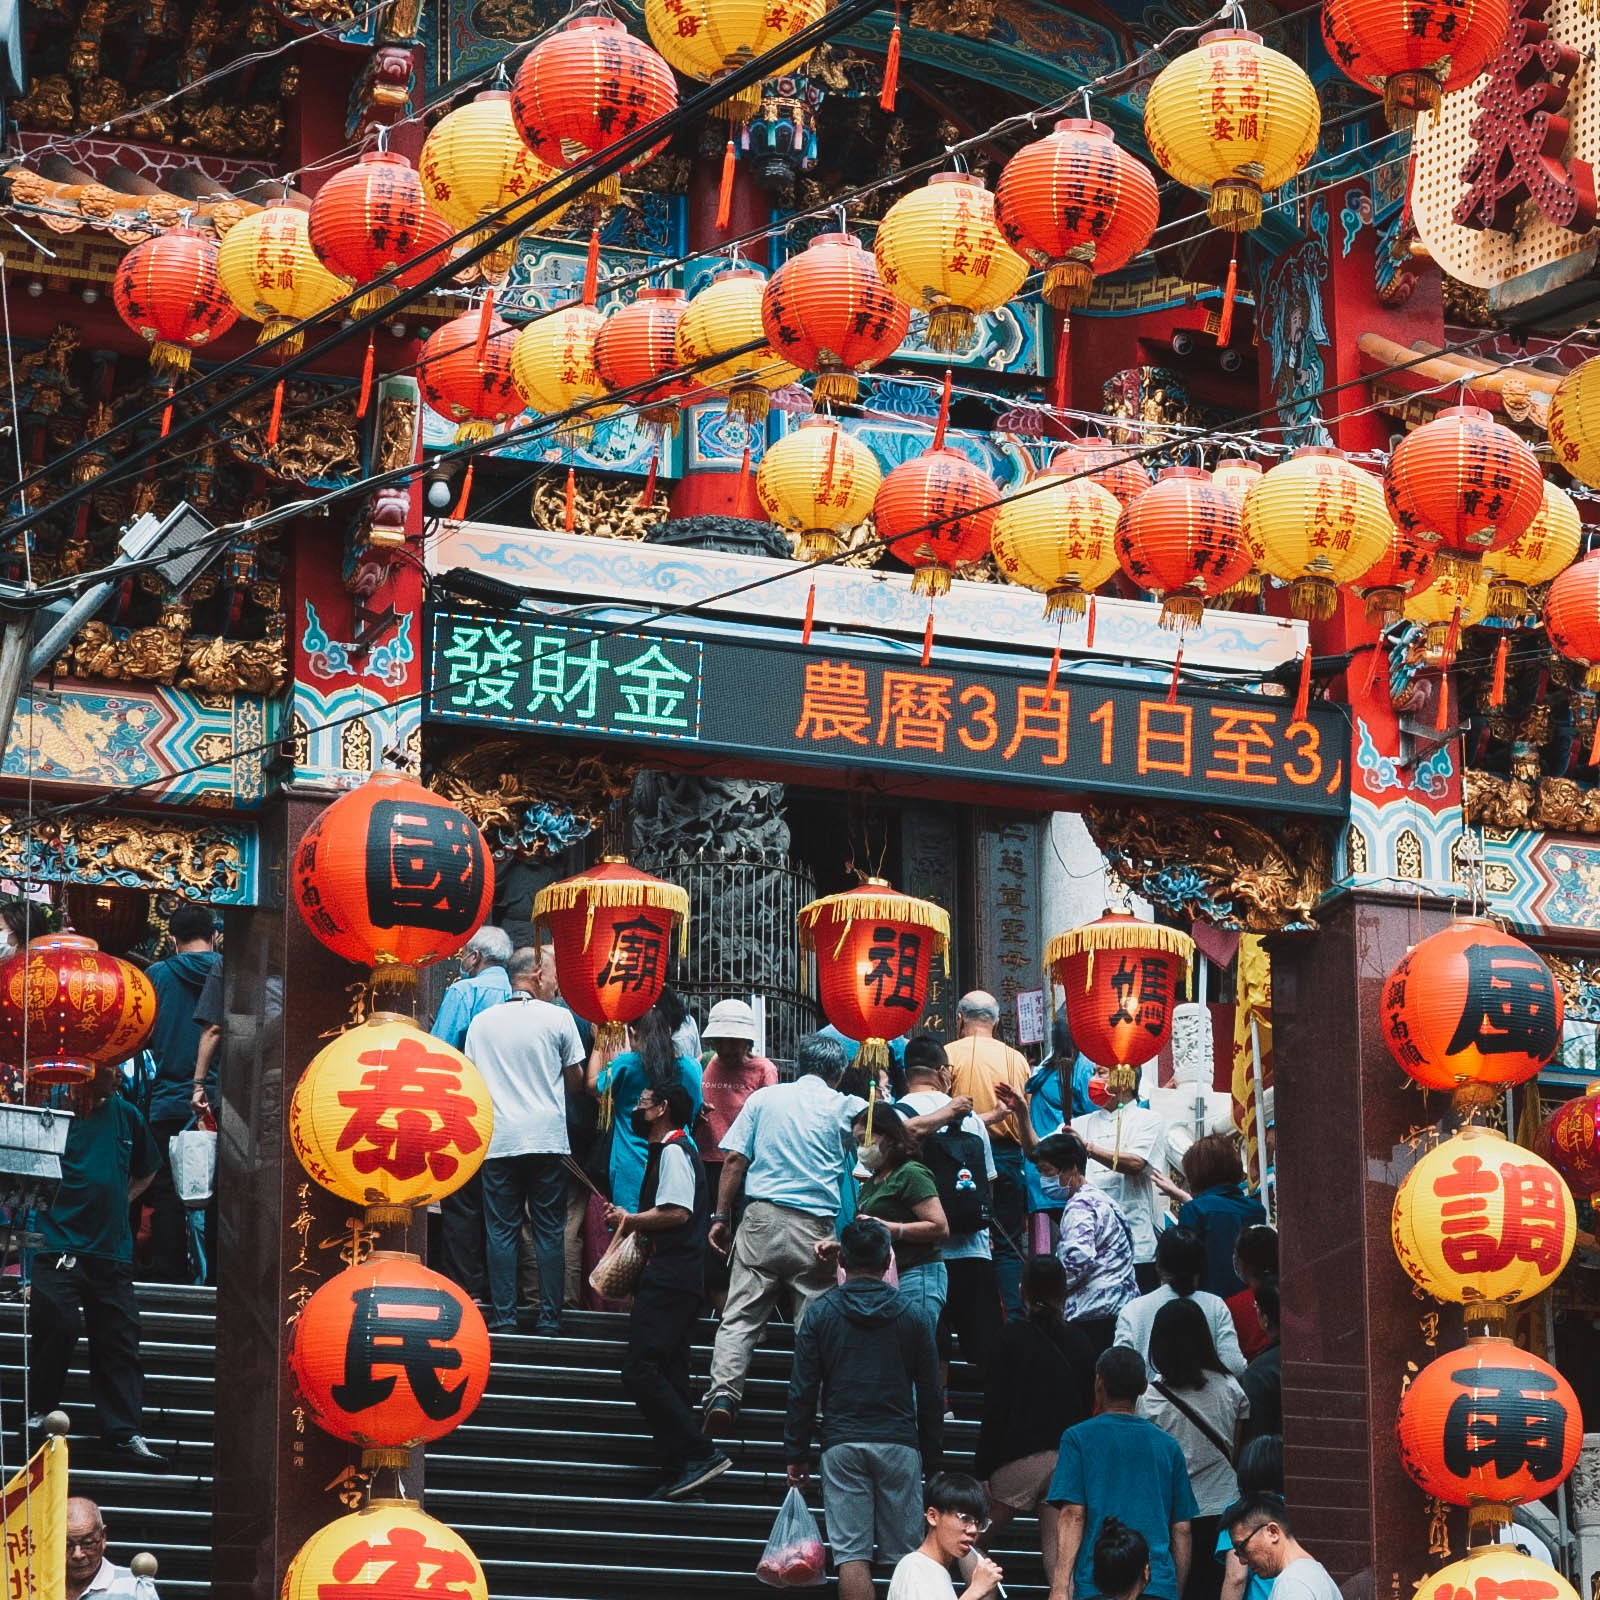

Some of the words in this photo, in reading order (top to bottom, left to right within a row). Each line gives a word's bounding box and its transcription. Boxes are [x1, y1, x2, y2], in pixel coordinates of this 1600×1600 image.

[442, 625, 693, 728] 發財金
[795, 660, 1343, 794] 農曆3月1日至3
[366, 800, 488, 934] 國
[599, 915, 659, 998] 廟
[864, 926, 923, 1013] 祖
[1108, 955, 1169, 1033] 媽
[336, 1039, 483, 1181] 泰
[1434, 1155, 1564, 1276] 調
[331, 1287, 472, 1419] 民
[1444, 1367, 1568, 1480] 雨
